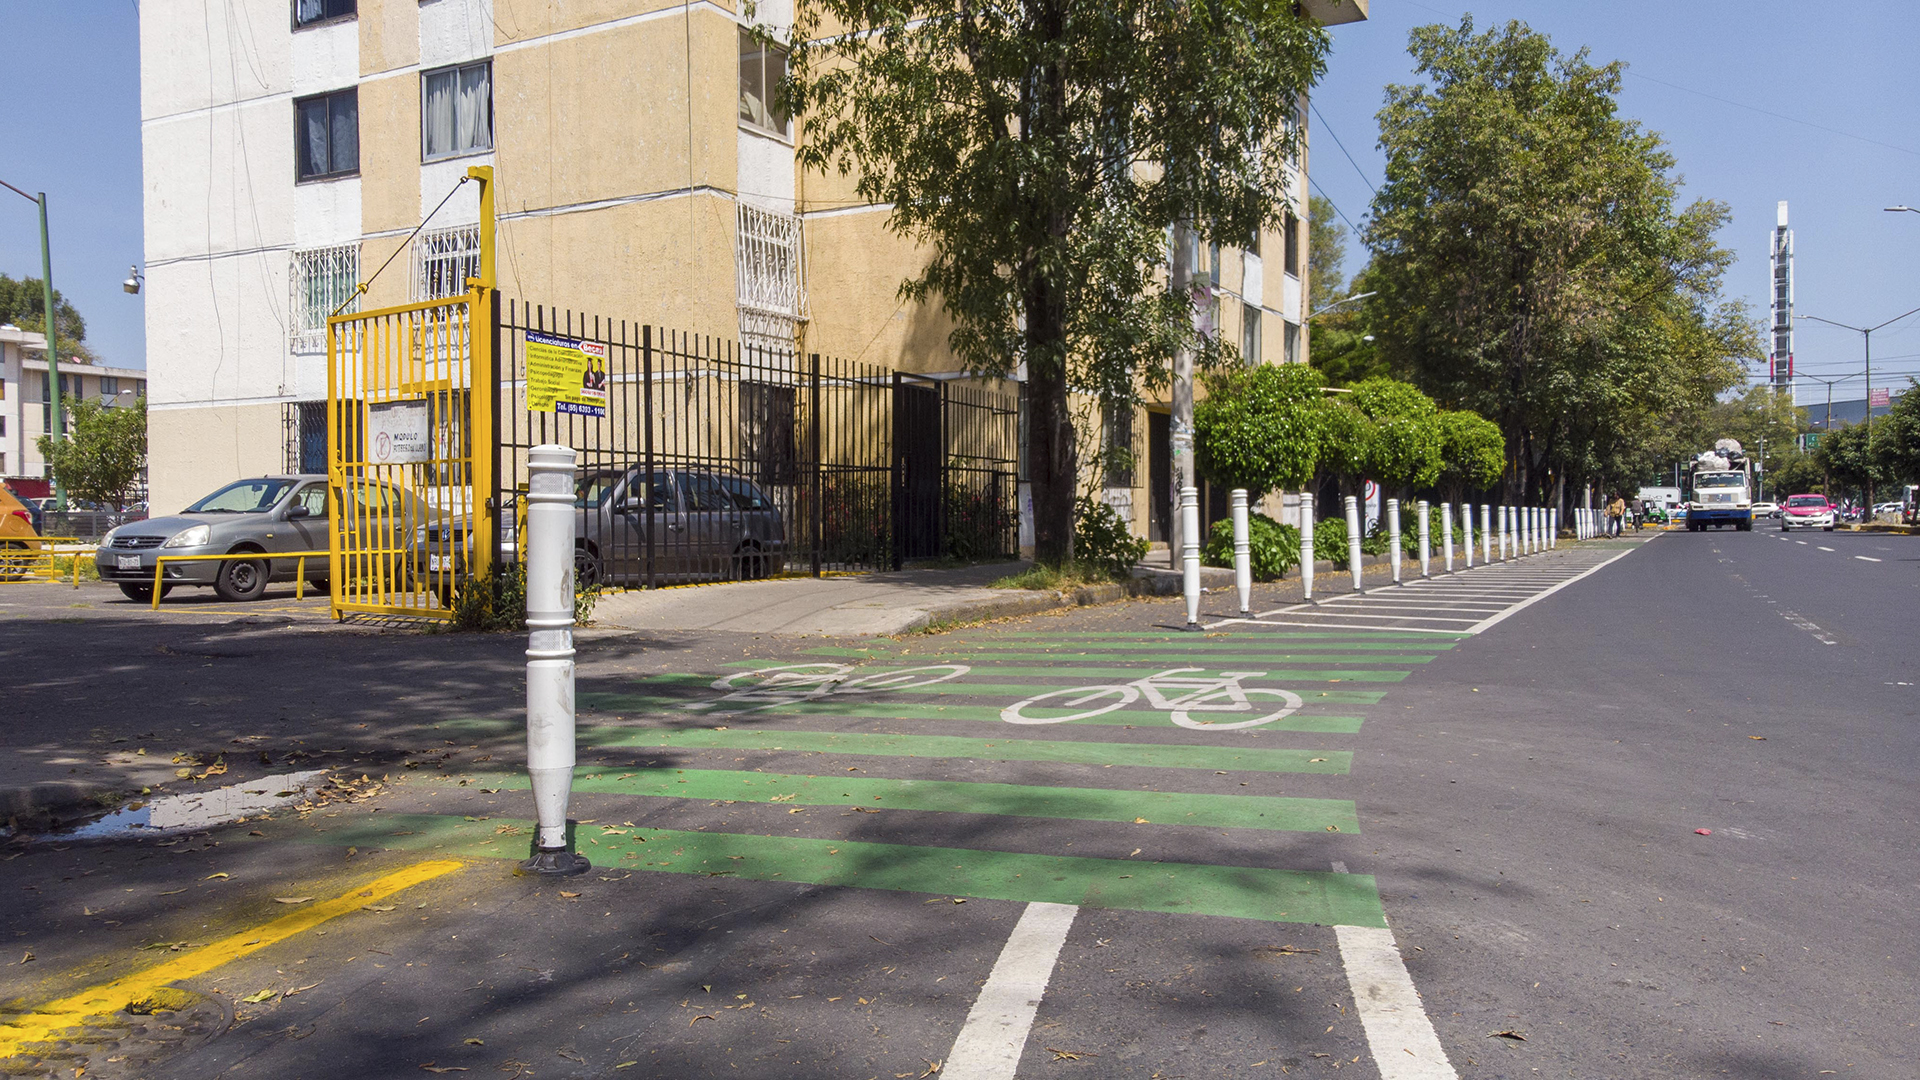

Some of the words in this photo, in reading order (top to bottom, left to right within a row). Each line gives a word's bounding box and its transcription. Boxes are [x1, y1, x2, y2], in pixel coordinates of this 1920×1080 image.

[583, 343, 602, 354] Becas
[557, 402, 567, 410] Tel.
[568, 404, 578, 413] (55)
